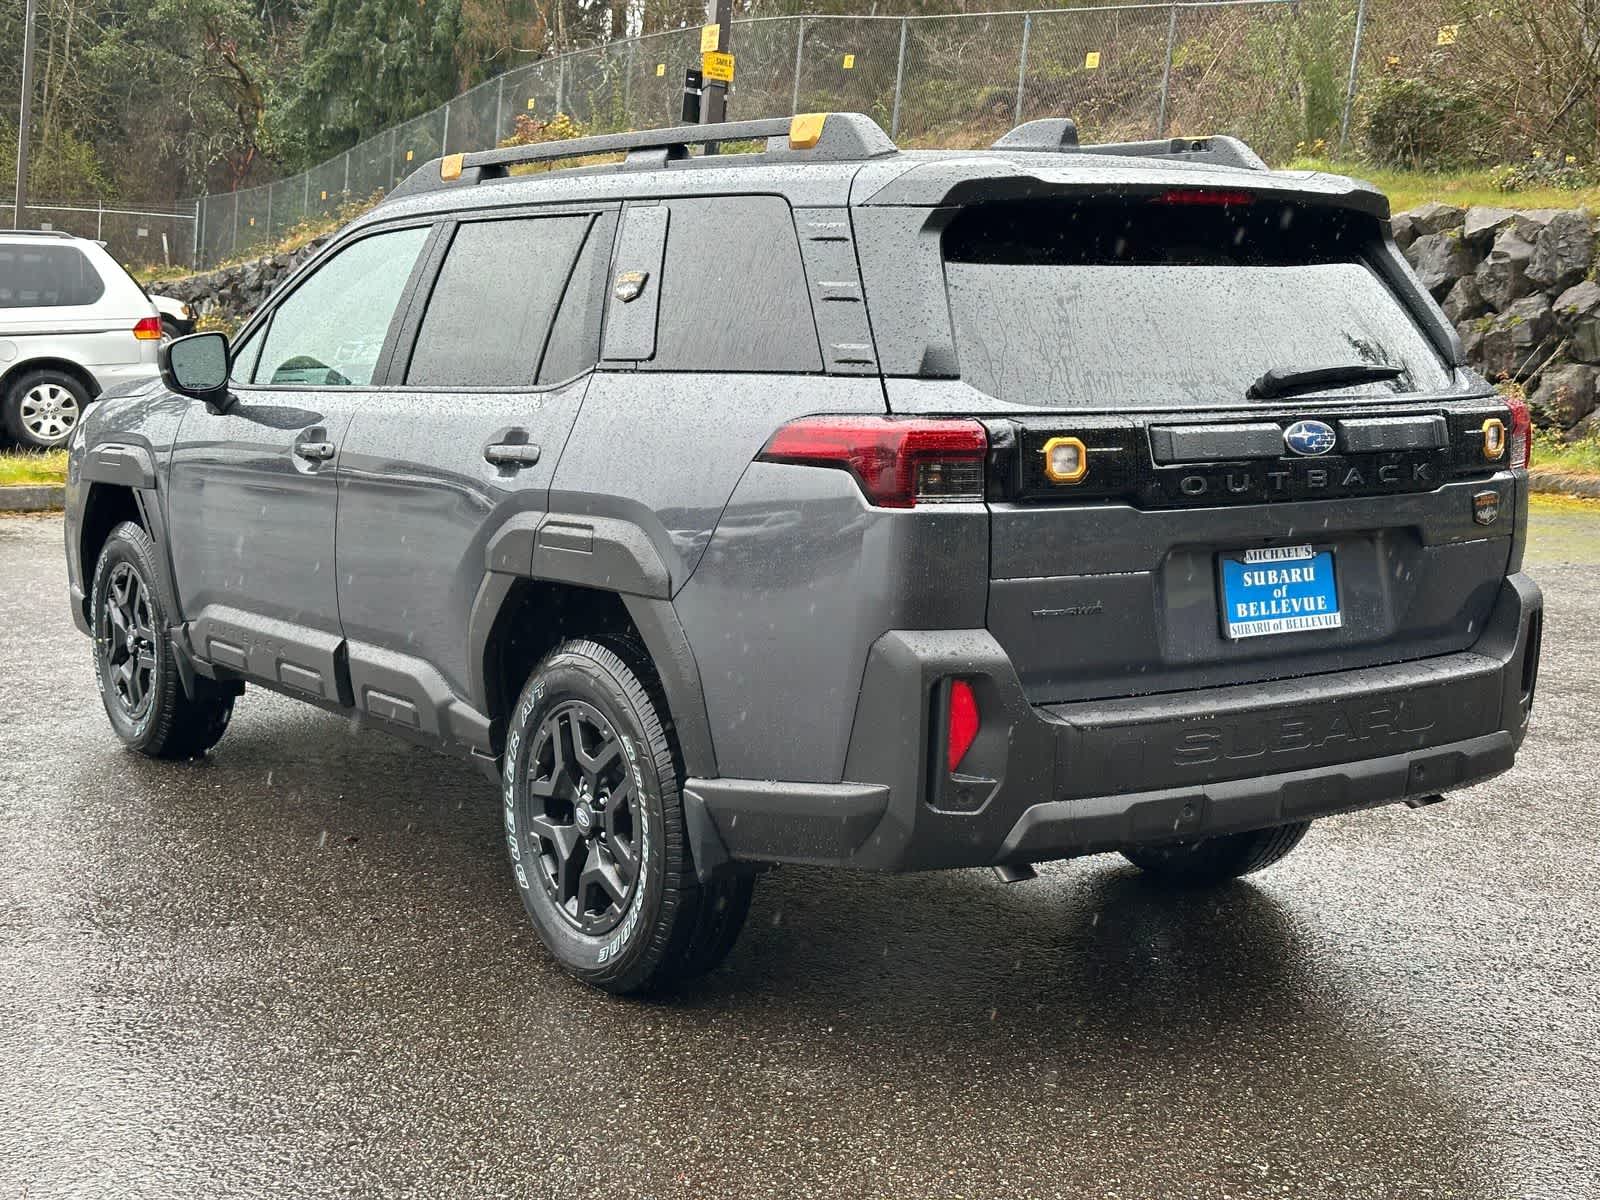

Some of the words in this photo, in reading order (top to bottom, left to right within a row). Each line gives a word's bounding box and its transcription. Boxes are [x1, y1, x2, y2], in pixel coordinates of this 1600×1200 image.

[1180, 462, 1432, 496] OUTBACK
[1246, 546, 1312, 561] MICHAEL'S
[1243, 567, 1315, 586] SUBARU
[1273, 585, 1287, 598] of
[1236, 596, 1327, 617] BELLEVUE
[1231, 622, 1270, 636] SUBARU
[1273, 620, 1283, 631] of
[1286, 614, 1339, 630] BELLEVUE
[1173, 702, 1437, 766] SUBARU
[503, 730, 530, 890] DUELER
[520, 679, 546, 728] A/T
